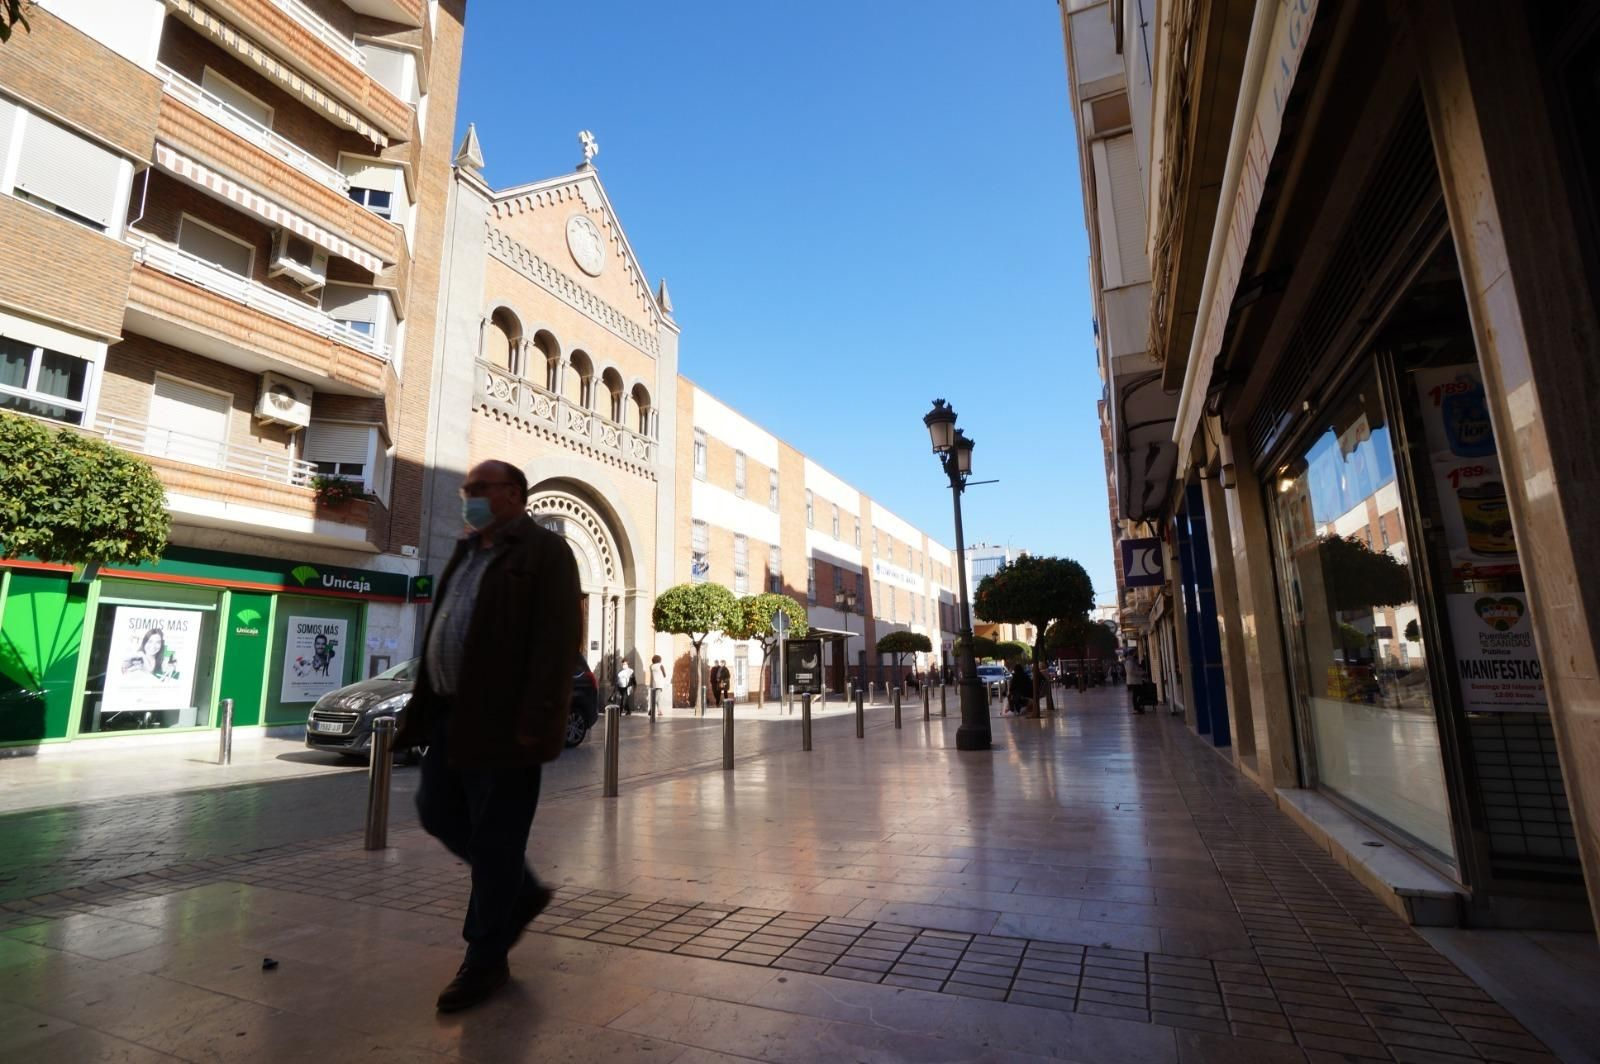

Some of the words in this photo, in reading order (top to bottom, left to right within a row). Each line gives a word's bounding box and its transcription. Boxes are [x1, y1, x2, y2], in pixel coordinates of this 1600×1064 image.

[322, 574, 371, 593] Unicaja
[128, 617, 165, 631] SOMOS
[296, 623, 323, 636] SOMOS
[323, 624, 340, 636] MÁS
